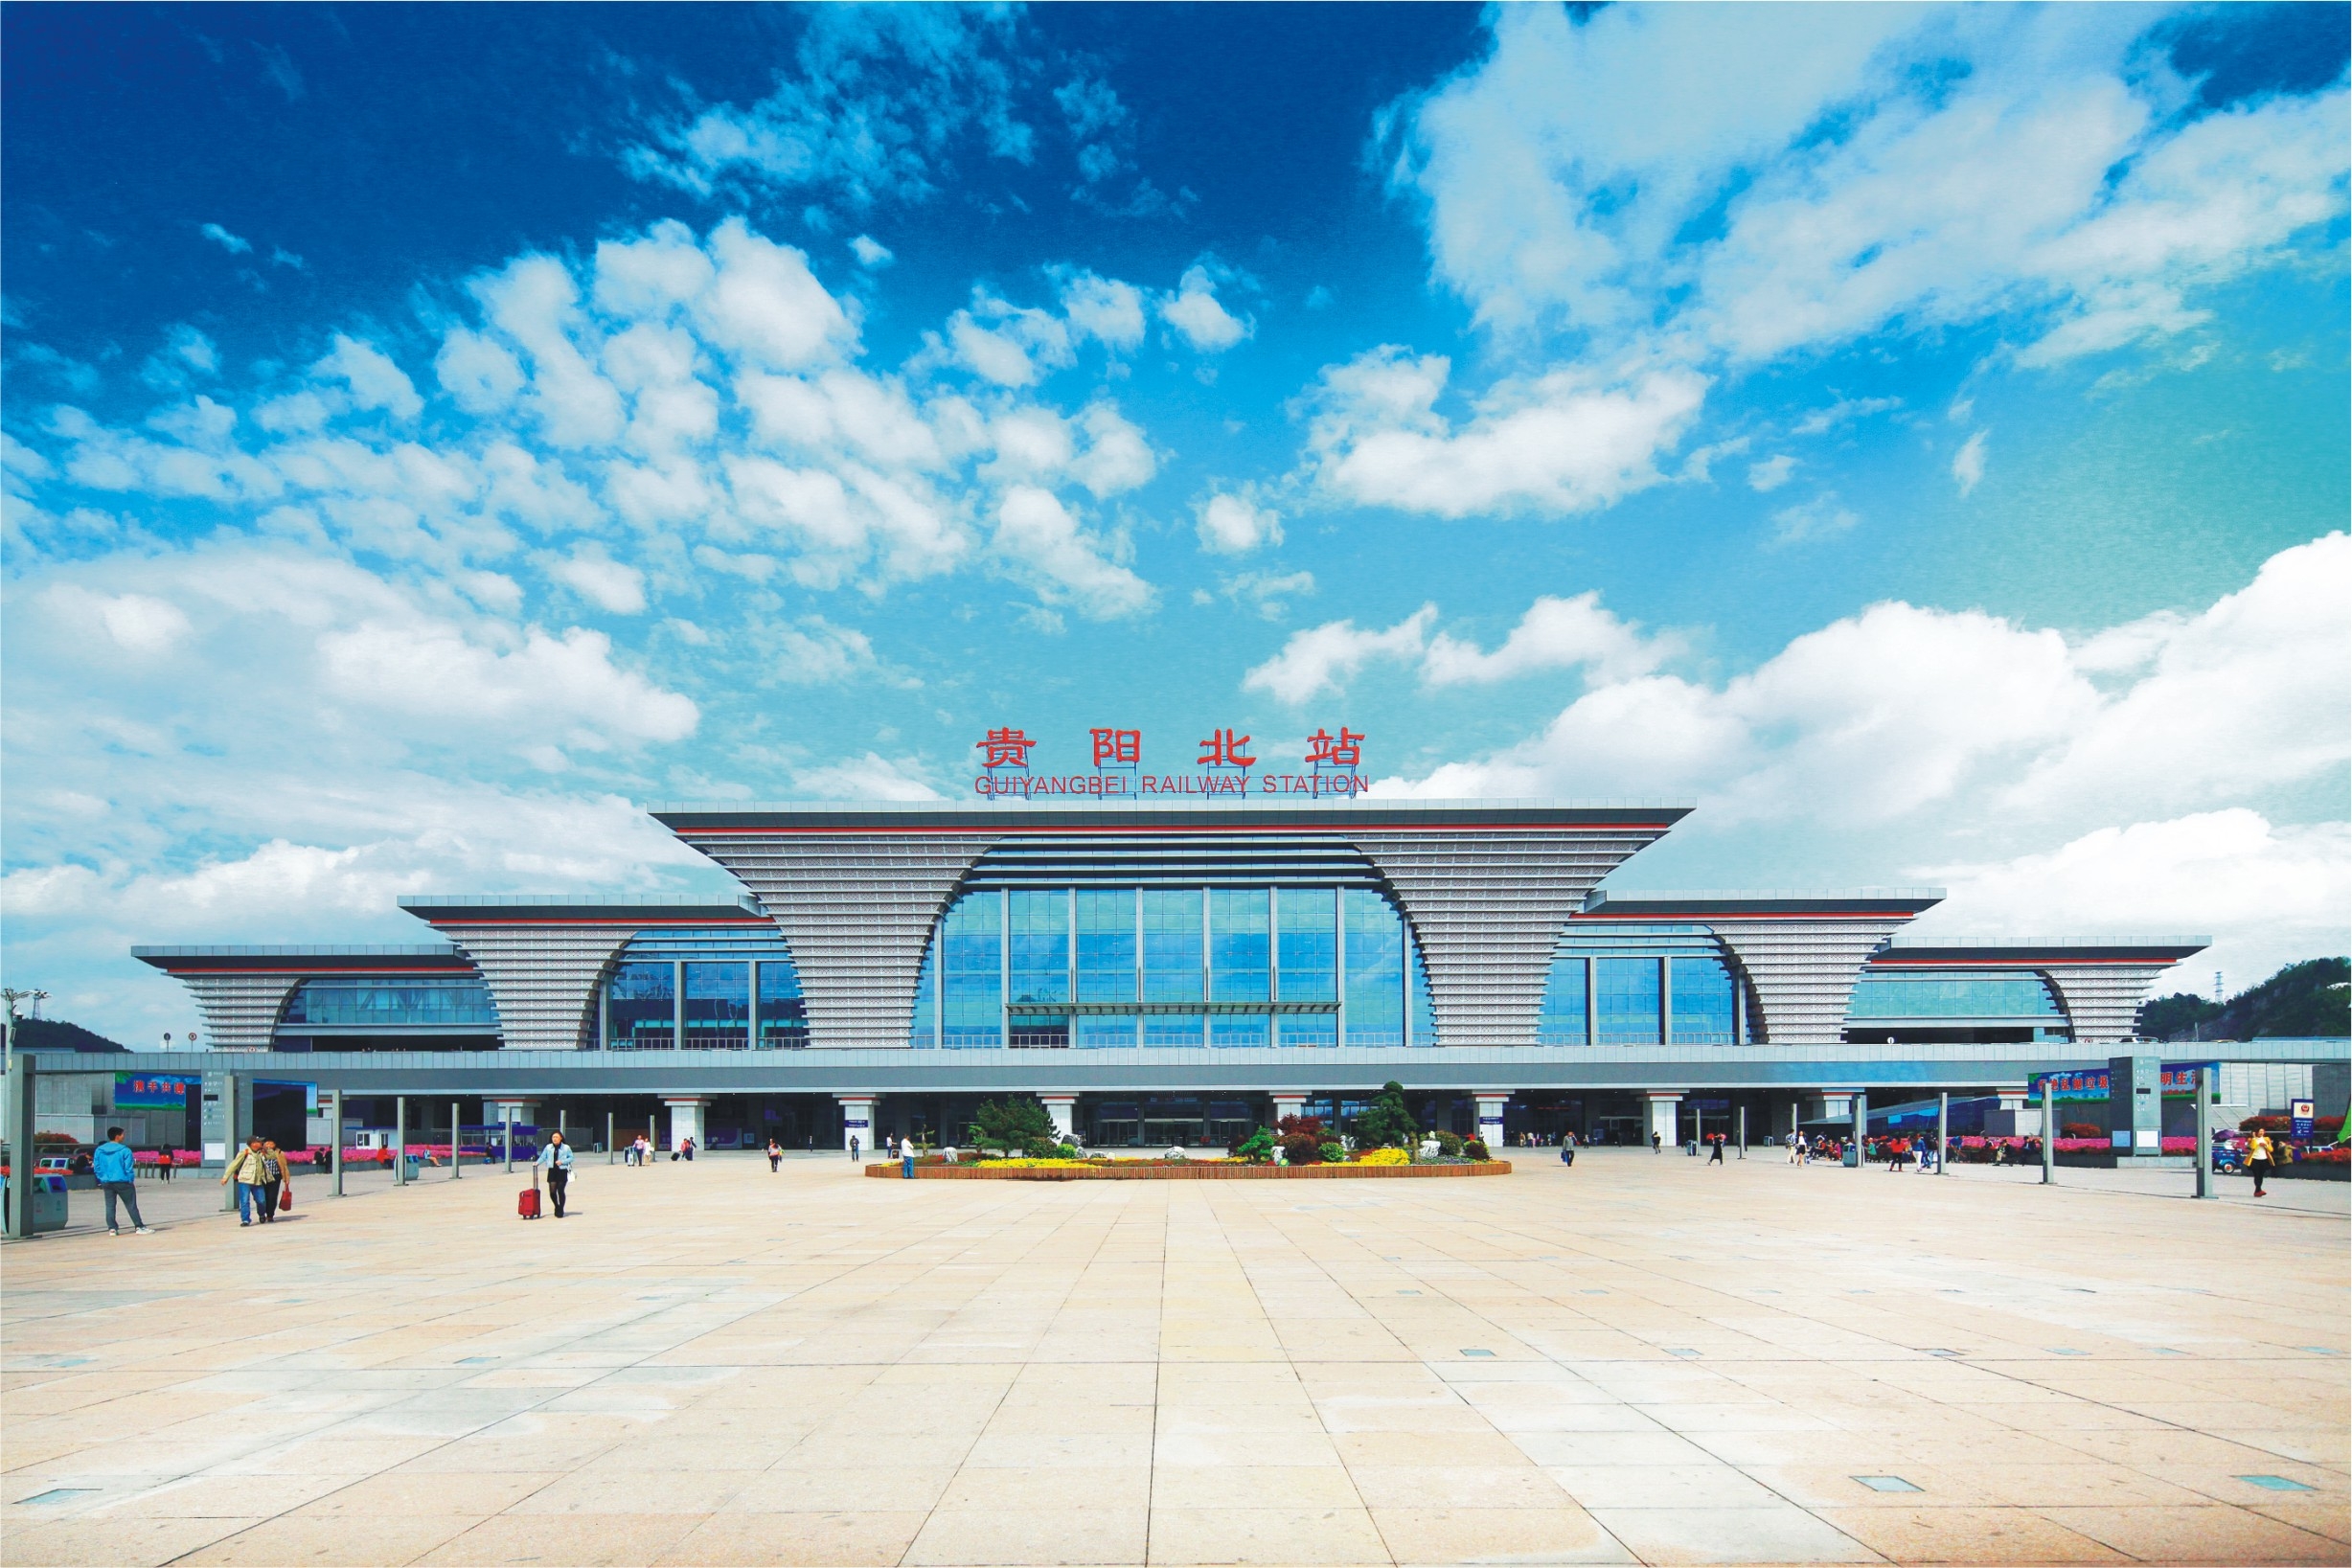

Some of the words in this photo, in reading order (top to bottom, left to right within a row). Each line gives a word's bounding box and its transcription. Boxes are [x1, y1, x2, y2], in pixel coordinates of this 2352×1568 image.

[975, 726, 1366, 767] 贵阳北站
[974, 775, 1127, 794] GUIYANGBEI
[1141, 775, 1250, 794] RAILWAY
[1262, 774, 1369, 794] STATION
